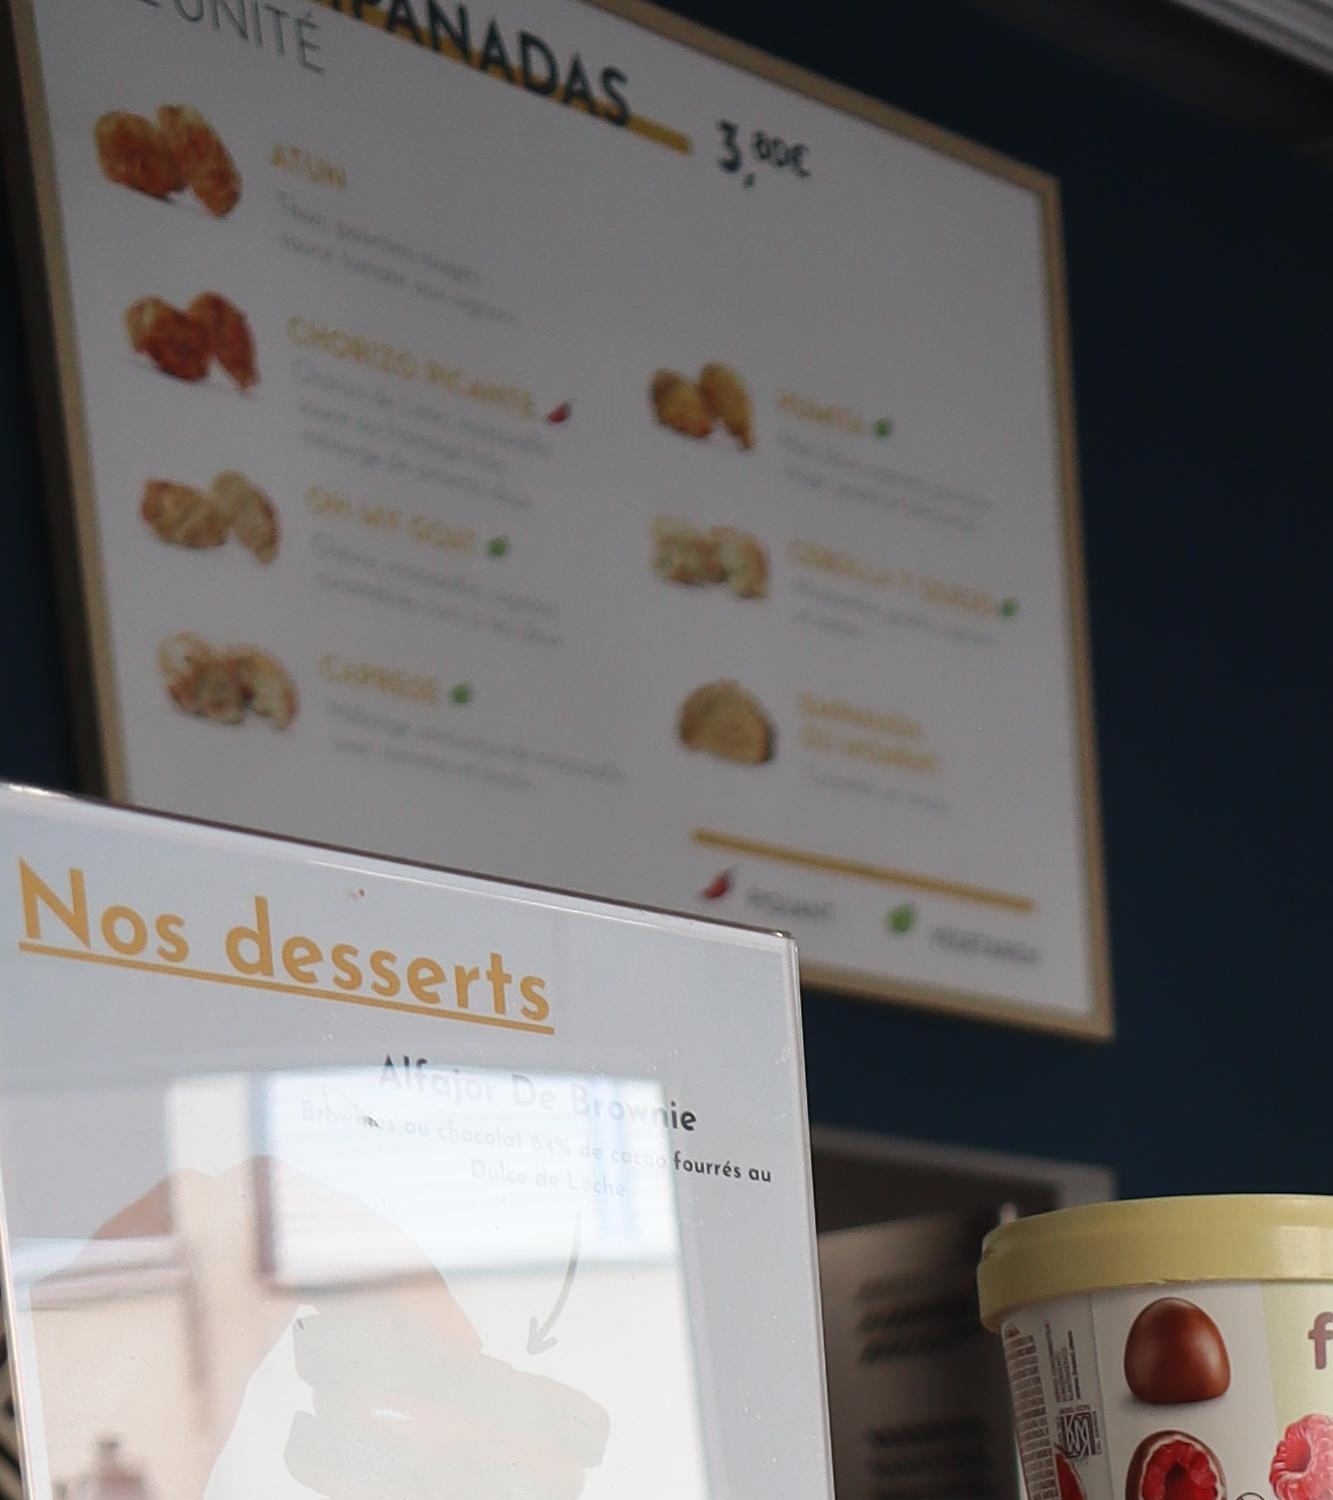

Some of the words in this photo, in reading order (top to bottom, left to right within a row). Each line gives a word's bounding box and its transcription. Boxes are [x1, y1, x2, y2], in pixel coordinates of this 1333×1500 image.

[18, 855, 190, 963] Nos
[225, 894, 552, 1023] desserts
[572, 1083, 698, 1133] Brownie
[568, 1172, 626, 1198] Leche
[611, 1147, 666, 1169] cacao
[673, 1151, 742, 1181] fourrés
[749, 1166, 773, 1184] au
